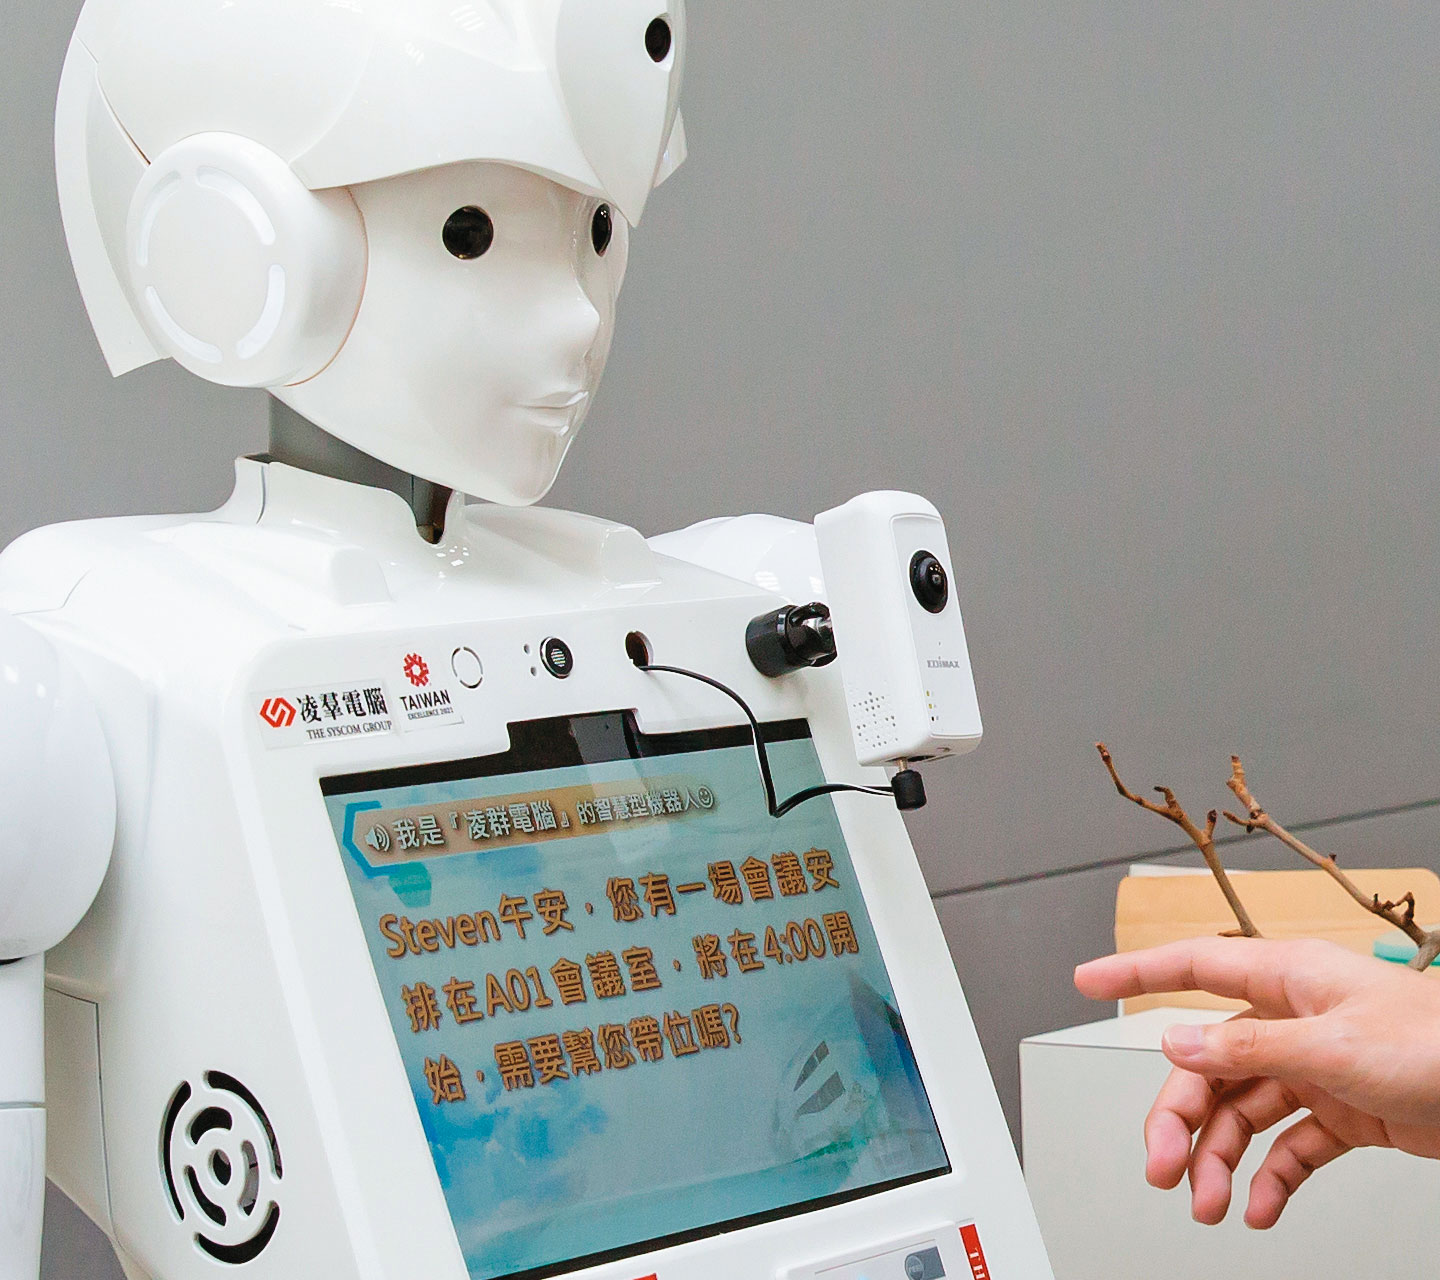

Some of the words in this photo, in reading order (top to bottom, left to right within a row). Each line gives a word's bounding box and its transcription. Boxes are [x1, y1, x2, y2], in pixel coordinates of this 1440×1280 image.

[399, 689, 451, 712] TAIWAN
[306, 727, 326, 740] THE
[327, 723, 362, 738] SYSCOM
[363, 720, 392, 735] GROUP
